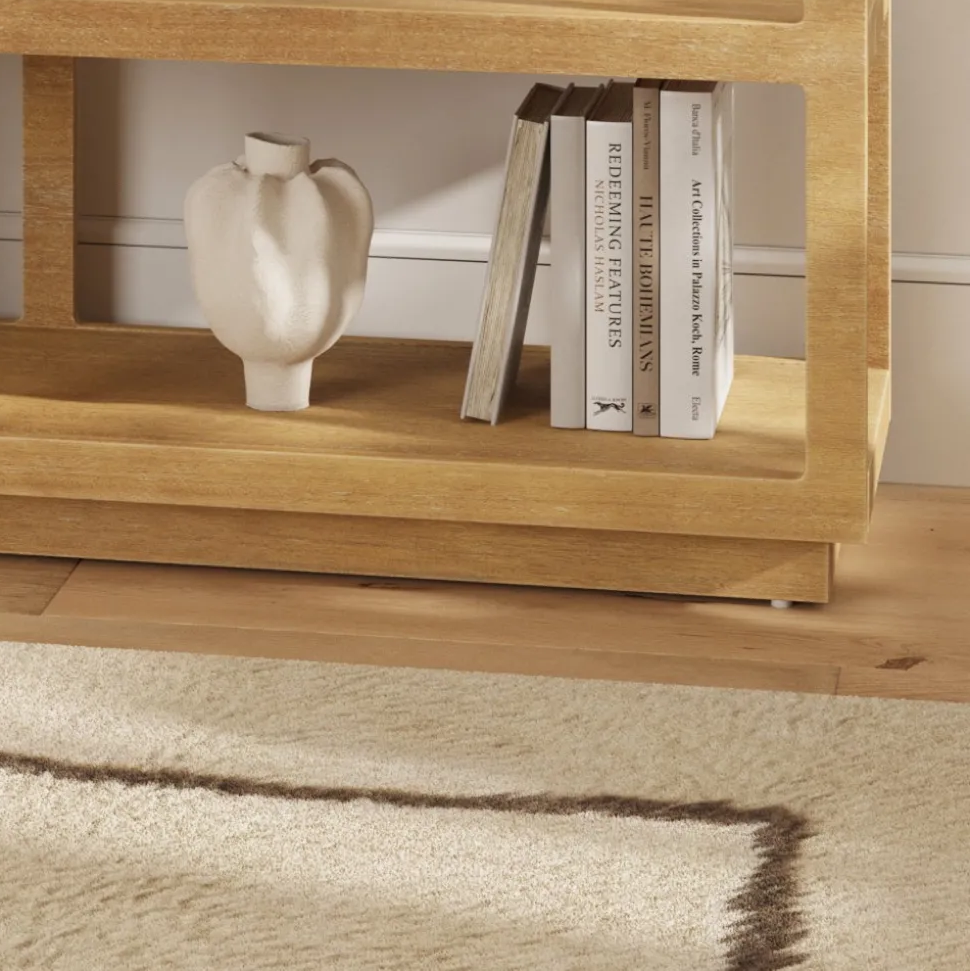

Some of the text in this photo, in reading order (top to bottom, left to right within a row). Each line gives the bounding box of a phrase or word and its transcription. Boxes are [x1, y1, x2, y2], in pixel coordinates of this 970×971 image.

[691, 104, 701, 156] Banca d'Italia
[594, 180, 605, 313] NICHOLAS HASLAM
[608, 143, 622, 348] REDEEMING FEATURES
[639, 196, 653, 372] HAUTE BOHEMIANS
[689, 179, 703, 376] Art Collections in Palazzo Koch, Rome
[691, 397, 701, 421] Electa
